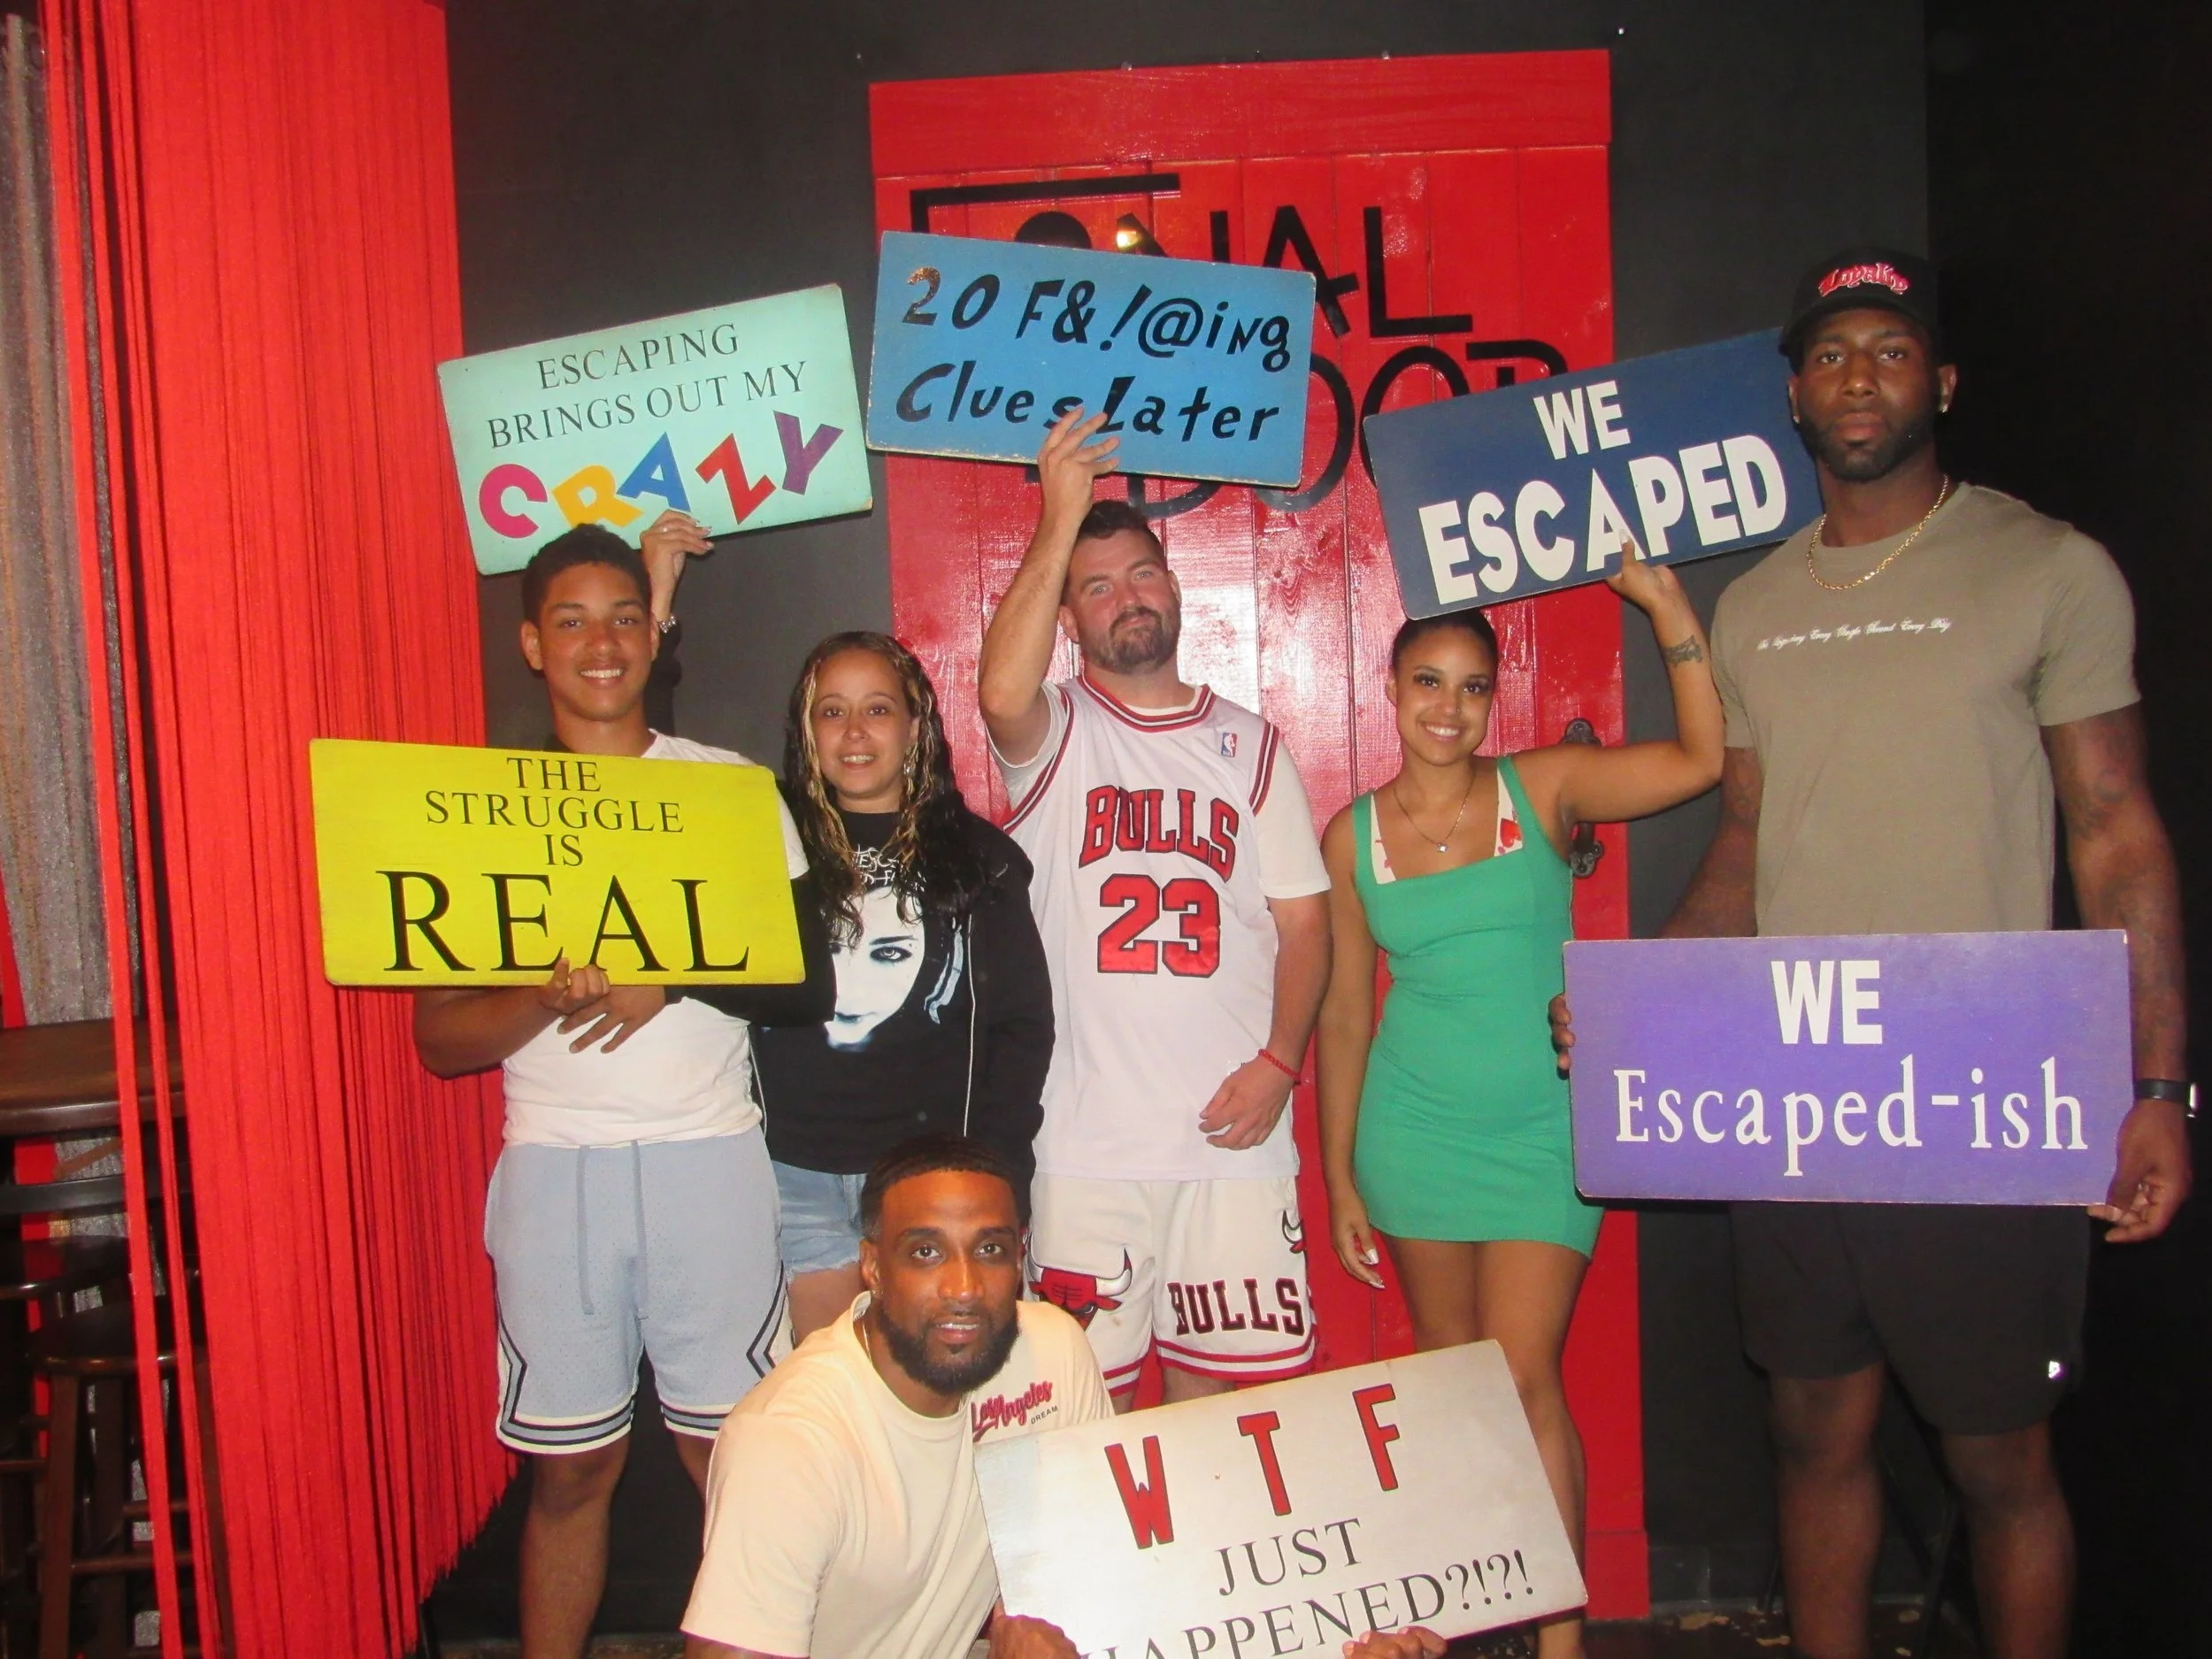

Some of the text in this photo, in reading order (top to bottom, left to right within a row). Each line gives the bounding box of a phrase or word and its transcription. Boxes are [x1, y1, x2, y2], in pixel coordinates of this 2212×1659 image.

[902, 266, 1000, 329] 20
[537, 324, 739, 390] ESCAPING
[488, 361, 808, 449] BRINGS OUT MY
[895, 360, 1280, 442] Clues Later
[1533, 380, 1631, 460] WE
[479, 411, 844, 539] CRAZY
[1418, 434, 1787, 605] ESCAPED
[426, 790, 685, 833] STRUGGLE
[506, 757, 602, 793] THE
[544, 833, 584, 867] IS
[1079, 784, 1239, 883] BULLS
[375, 870, 750, 972] REAL
[1097, 873, 1221, 979] 23
[1770, 960, 1883, 1045] WE
[1614, 1054, 2088, 1177] Escaped-ish
[1167, 1278, 1306, 1337] BULLS
[1031, 1405, 1059, 1425] DREAM
[1215, 1518, 1363, 1596] JUST
